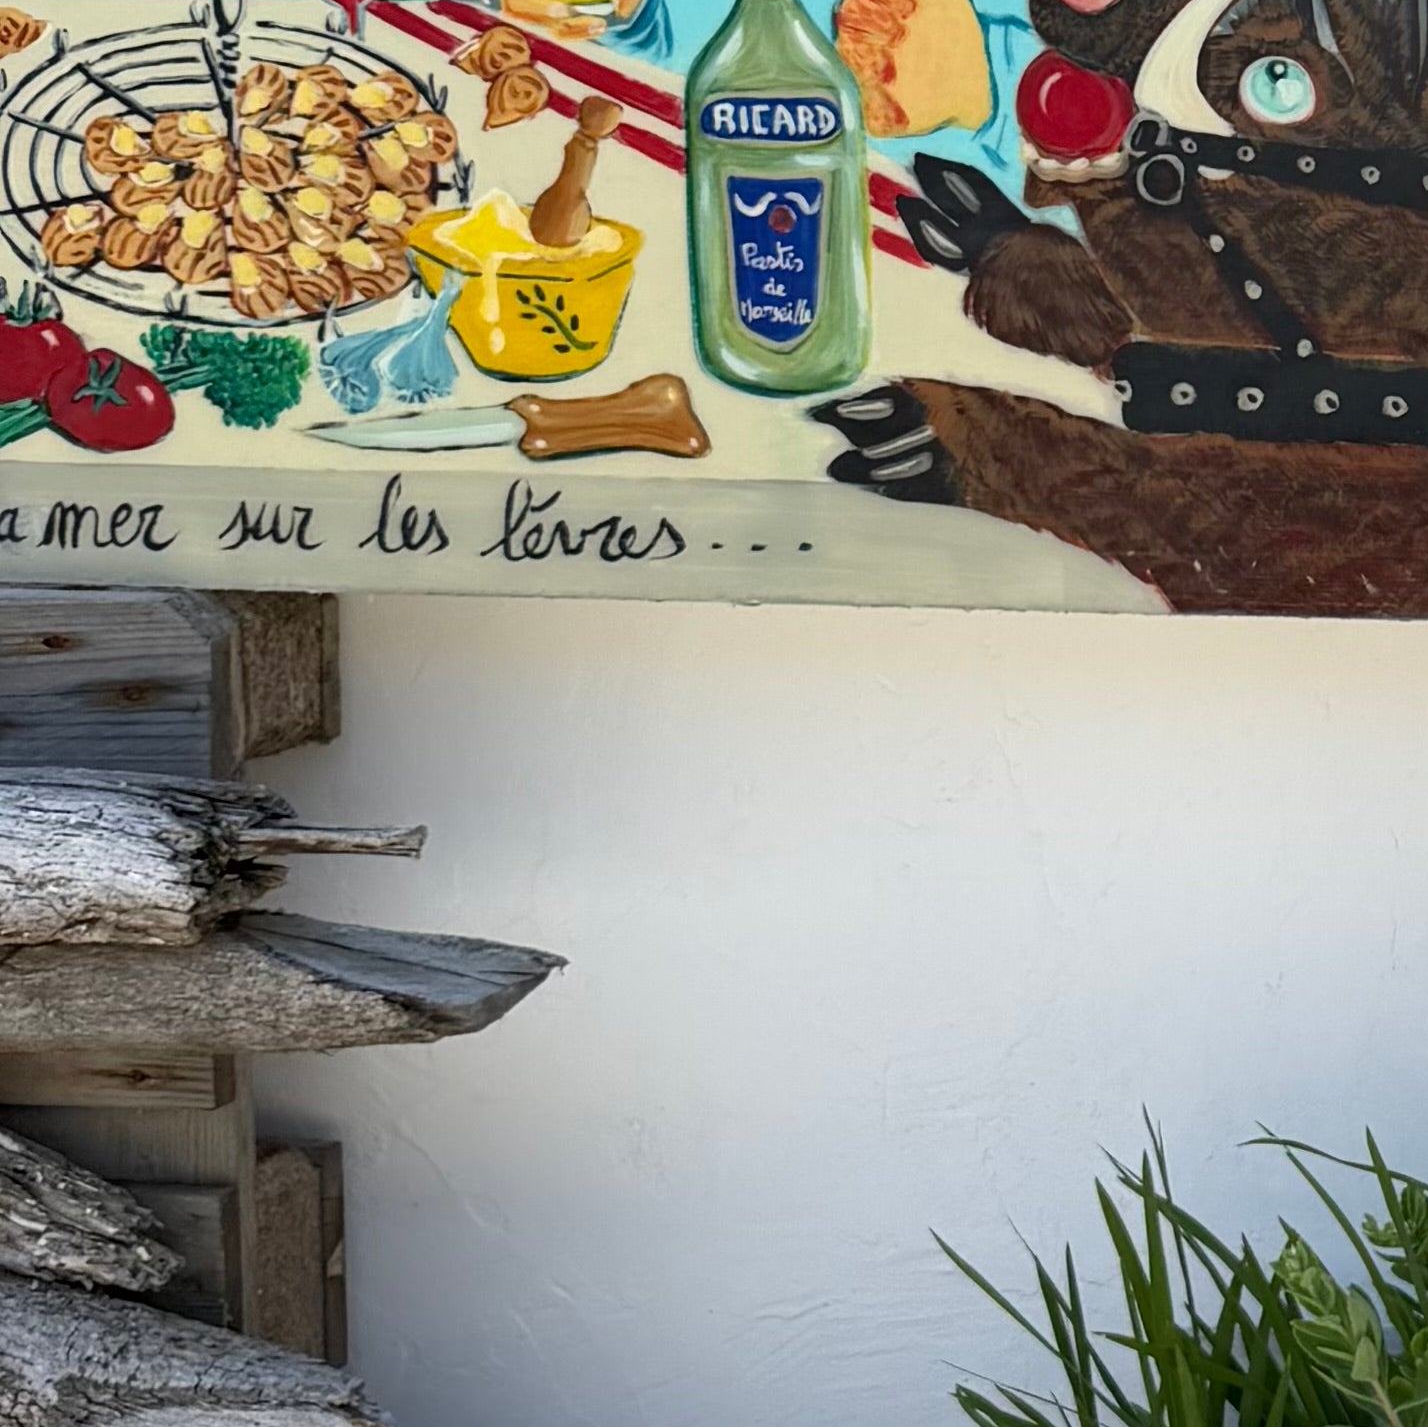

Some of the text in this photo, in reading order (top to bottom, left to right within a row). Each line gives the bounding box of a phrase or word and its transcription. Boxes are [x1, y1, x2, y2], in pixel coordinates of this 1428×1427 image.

[713, 102, 836, 136] RICARD
[742, 241, 804, 272] Pastis
[763, 277, 787, 297] de
[741, 298, 812, 325] Marseille
[36, 500, 181, 551] mer
[218, 500, 327, 550] sur
[357, 472, 449, 555] les
